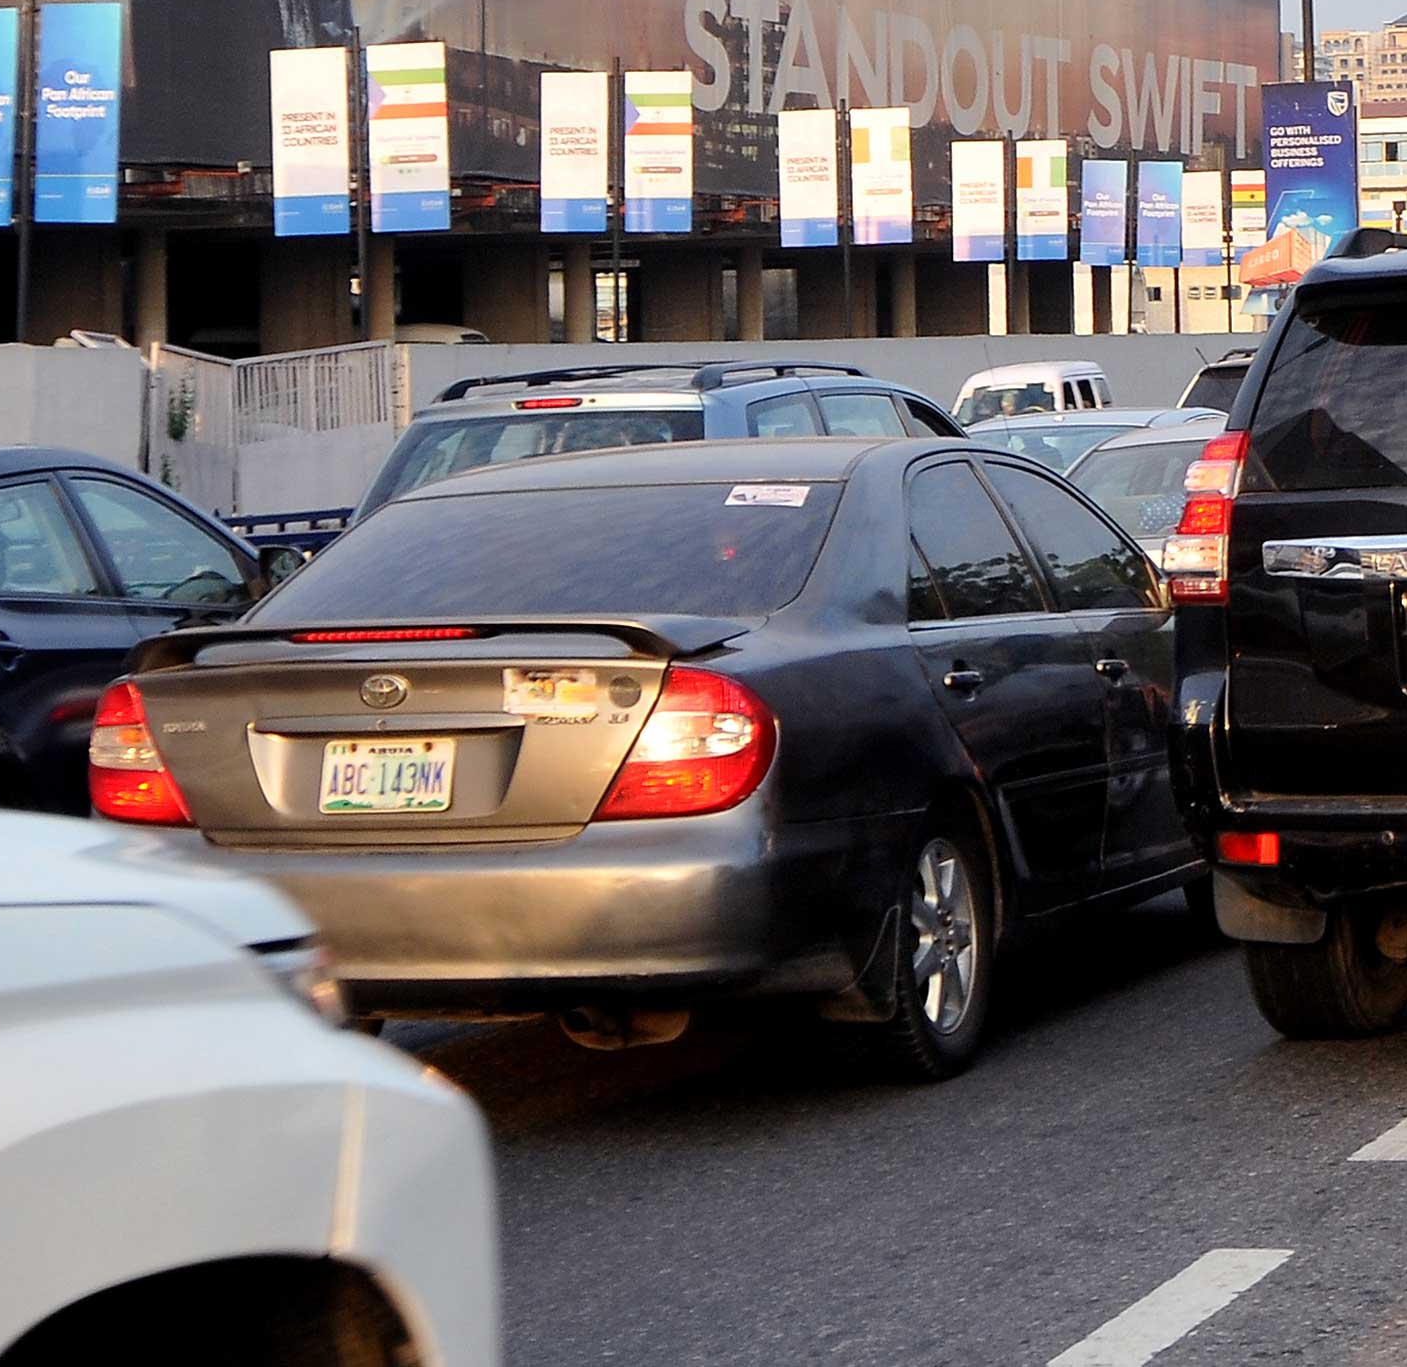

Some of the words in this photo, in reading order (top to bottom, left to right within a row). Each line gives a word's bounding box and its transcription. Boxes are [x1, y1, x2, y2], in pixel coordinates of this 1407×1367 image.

[65, 70, 91, 84] Our
[42, 87, 67, 101] Pan
[69, 87, 115, 101] African
[1087, 43, 1258, 159] SWIFT
[47, 104, 107, 120] Footprint
[282, 113, 324, 123] PRESENT
[326, 112, 335, 122] IN
[295, 124, 337, 134] AFRICAN
[550, 127, 586, 135] PRESENT
[1270, 127, 1284, 136] GO
[1286, 125, 1311, 135] WITH
[283, 136, 338, 147] COUNTRIES
[1270, 135, 1342, 147] PERSONALISED
[550, 147, 598, 156] COUNTRIES
[1271, 147, 1318, 158] BUSINESS
[1271, 157, 1324, 168] OFFERINGS
[796, 165, 829, 173] AFRICAN
[787, 175, 830, 183] COUNTRIES
[1152, 193, 1166, 201] Our
[1098, 201, 1123, 209] African
[1087, 209, 1119, 217] Footprint
[1143, 210, 1175, 218] Footprint
[1248, 249, 1280, 269] CARGO
